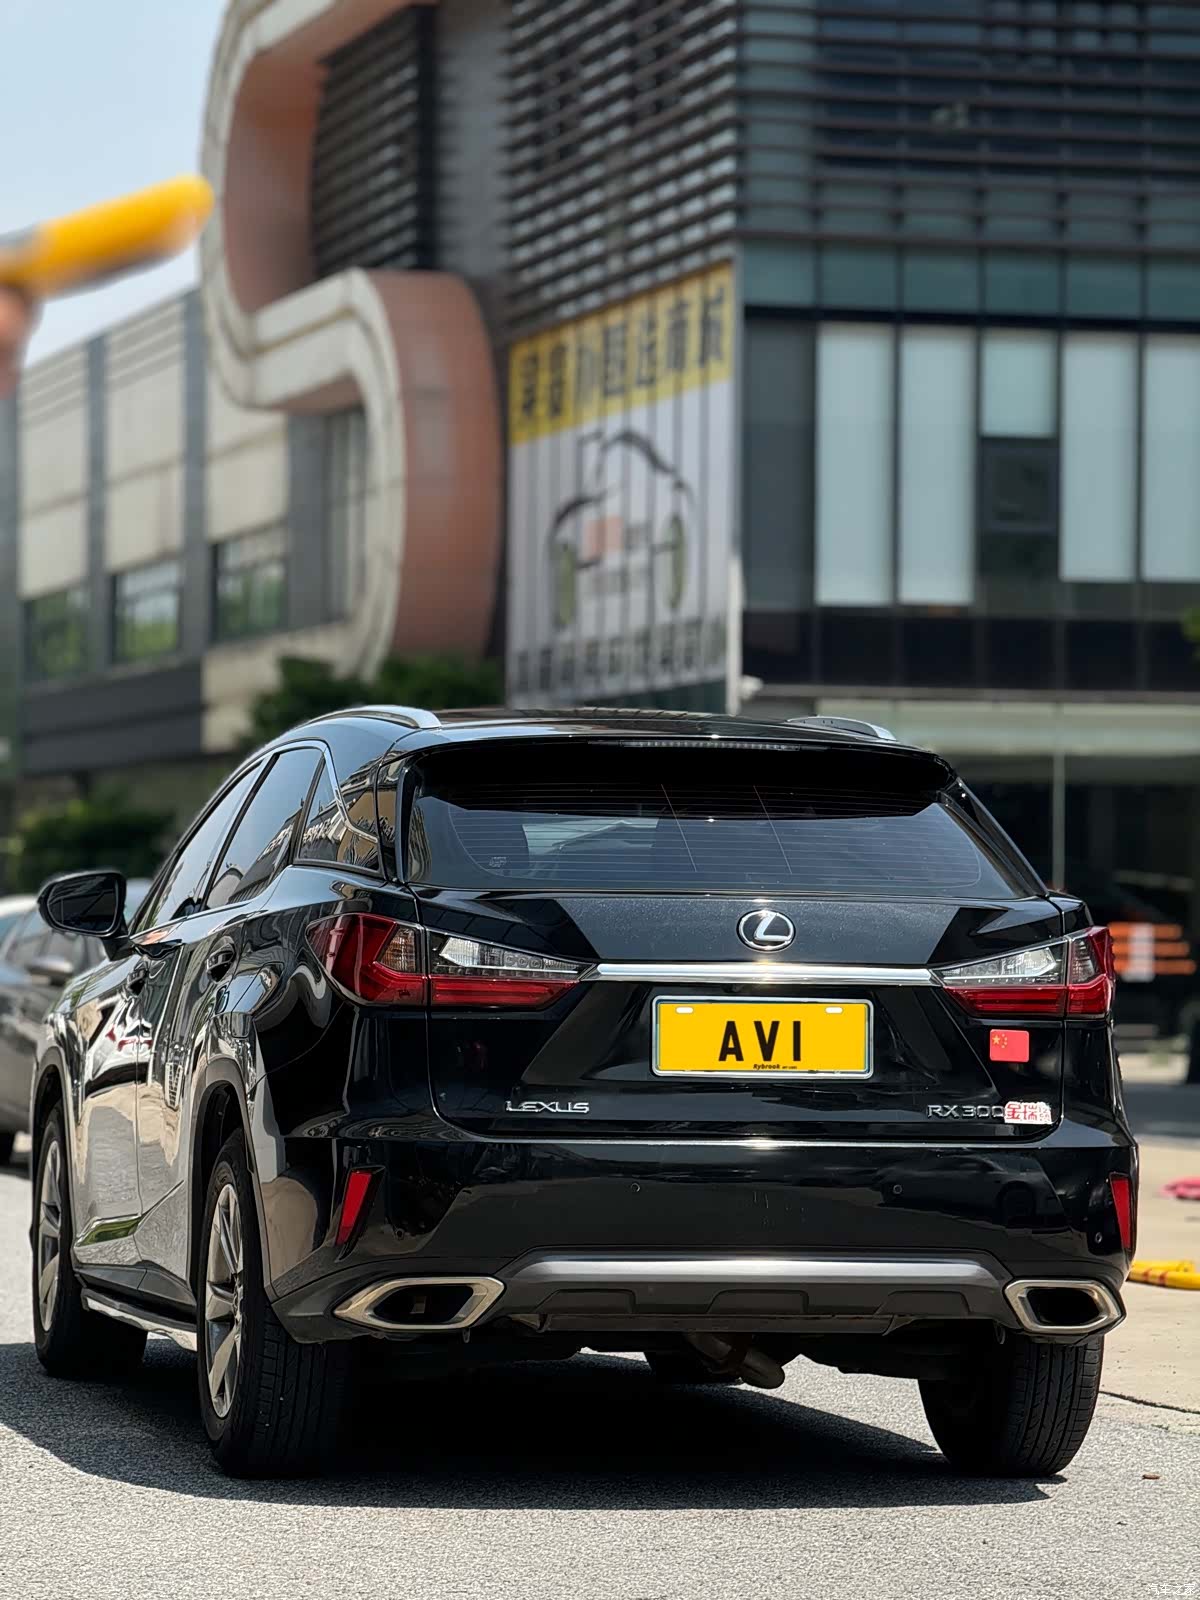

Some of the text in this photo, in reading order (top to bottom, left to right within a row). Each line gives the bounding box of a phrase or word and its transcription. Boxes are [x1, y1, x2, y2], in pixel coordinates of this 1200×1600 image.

[506, 1101, 589, 1113] LEXUS
[927, 1104, 1005, 1117] RX 300
